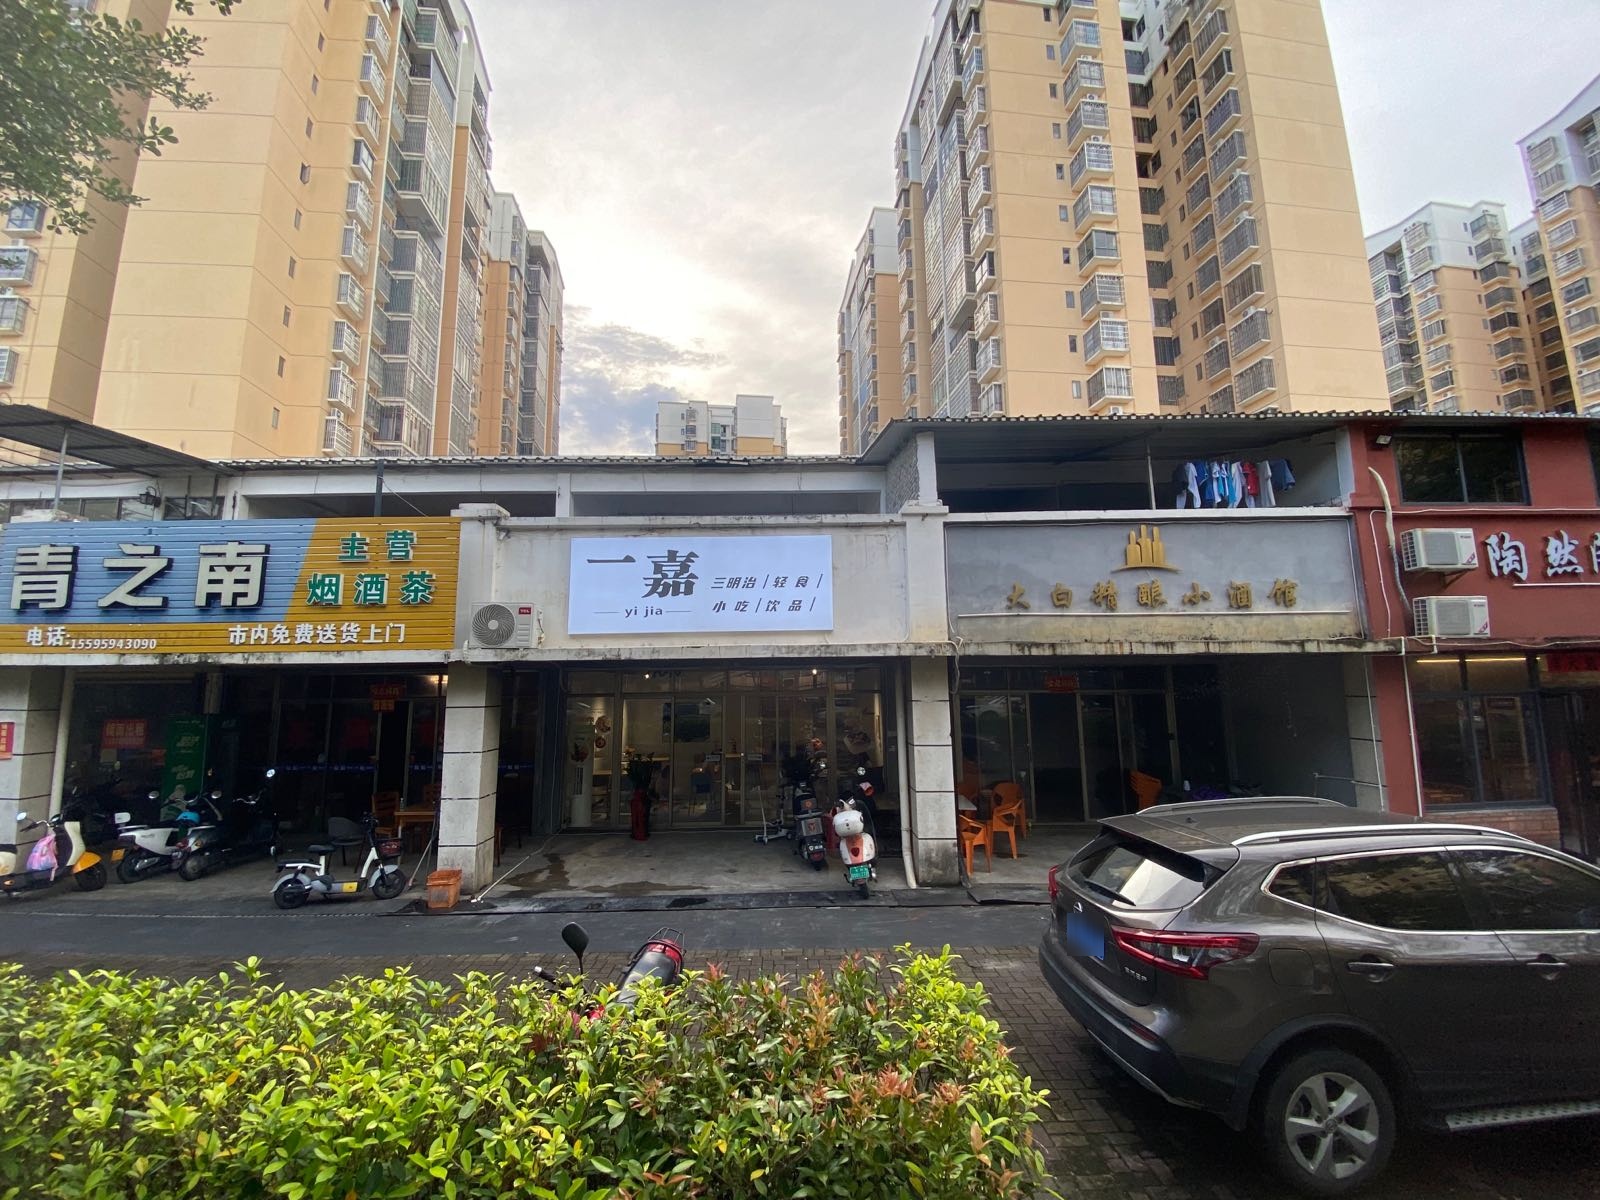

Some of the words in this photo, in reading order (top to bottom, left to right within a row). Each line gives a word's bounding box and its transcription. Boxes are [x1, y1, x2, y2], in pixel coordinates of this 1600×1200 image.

[337, 530, 417, 563] 主营
[1483, 529, 1600, 581] 陶然
[10, 540, 271, 609] 青之南
[305, 569, 437, 608] 烟酒茶
[586, 549, 700, 599] 一嘉
[625, 606, 639, 619] yi
[643, 606, 664, 618] jia
[228, 622, 406, 645] 市内免费送货上门
